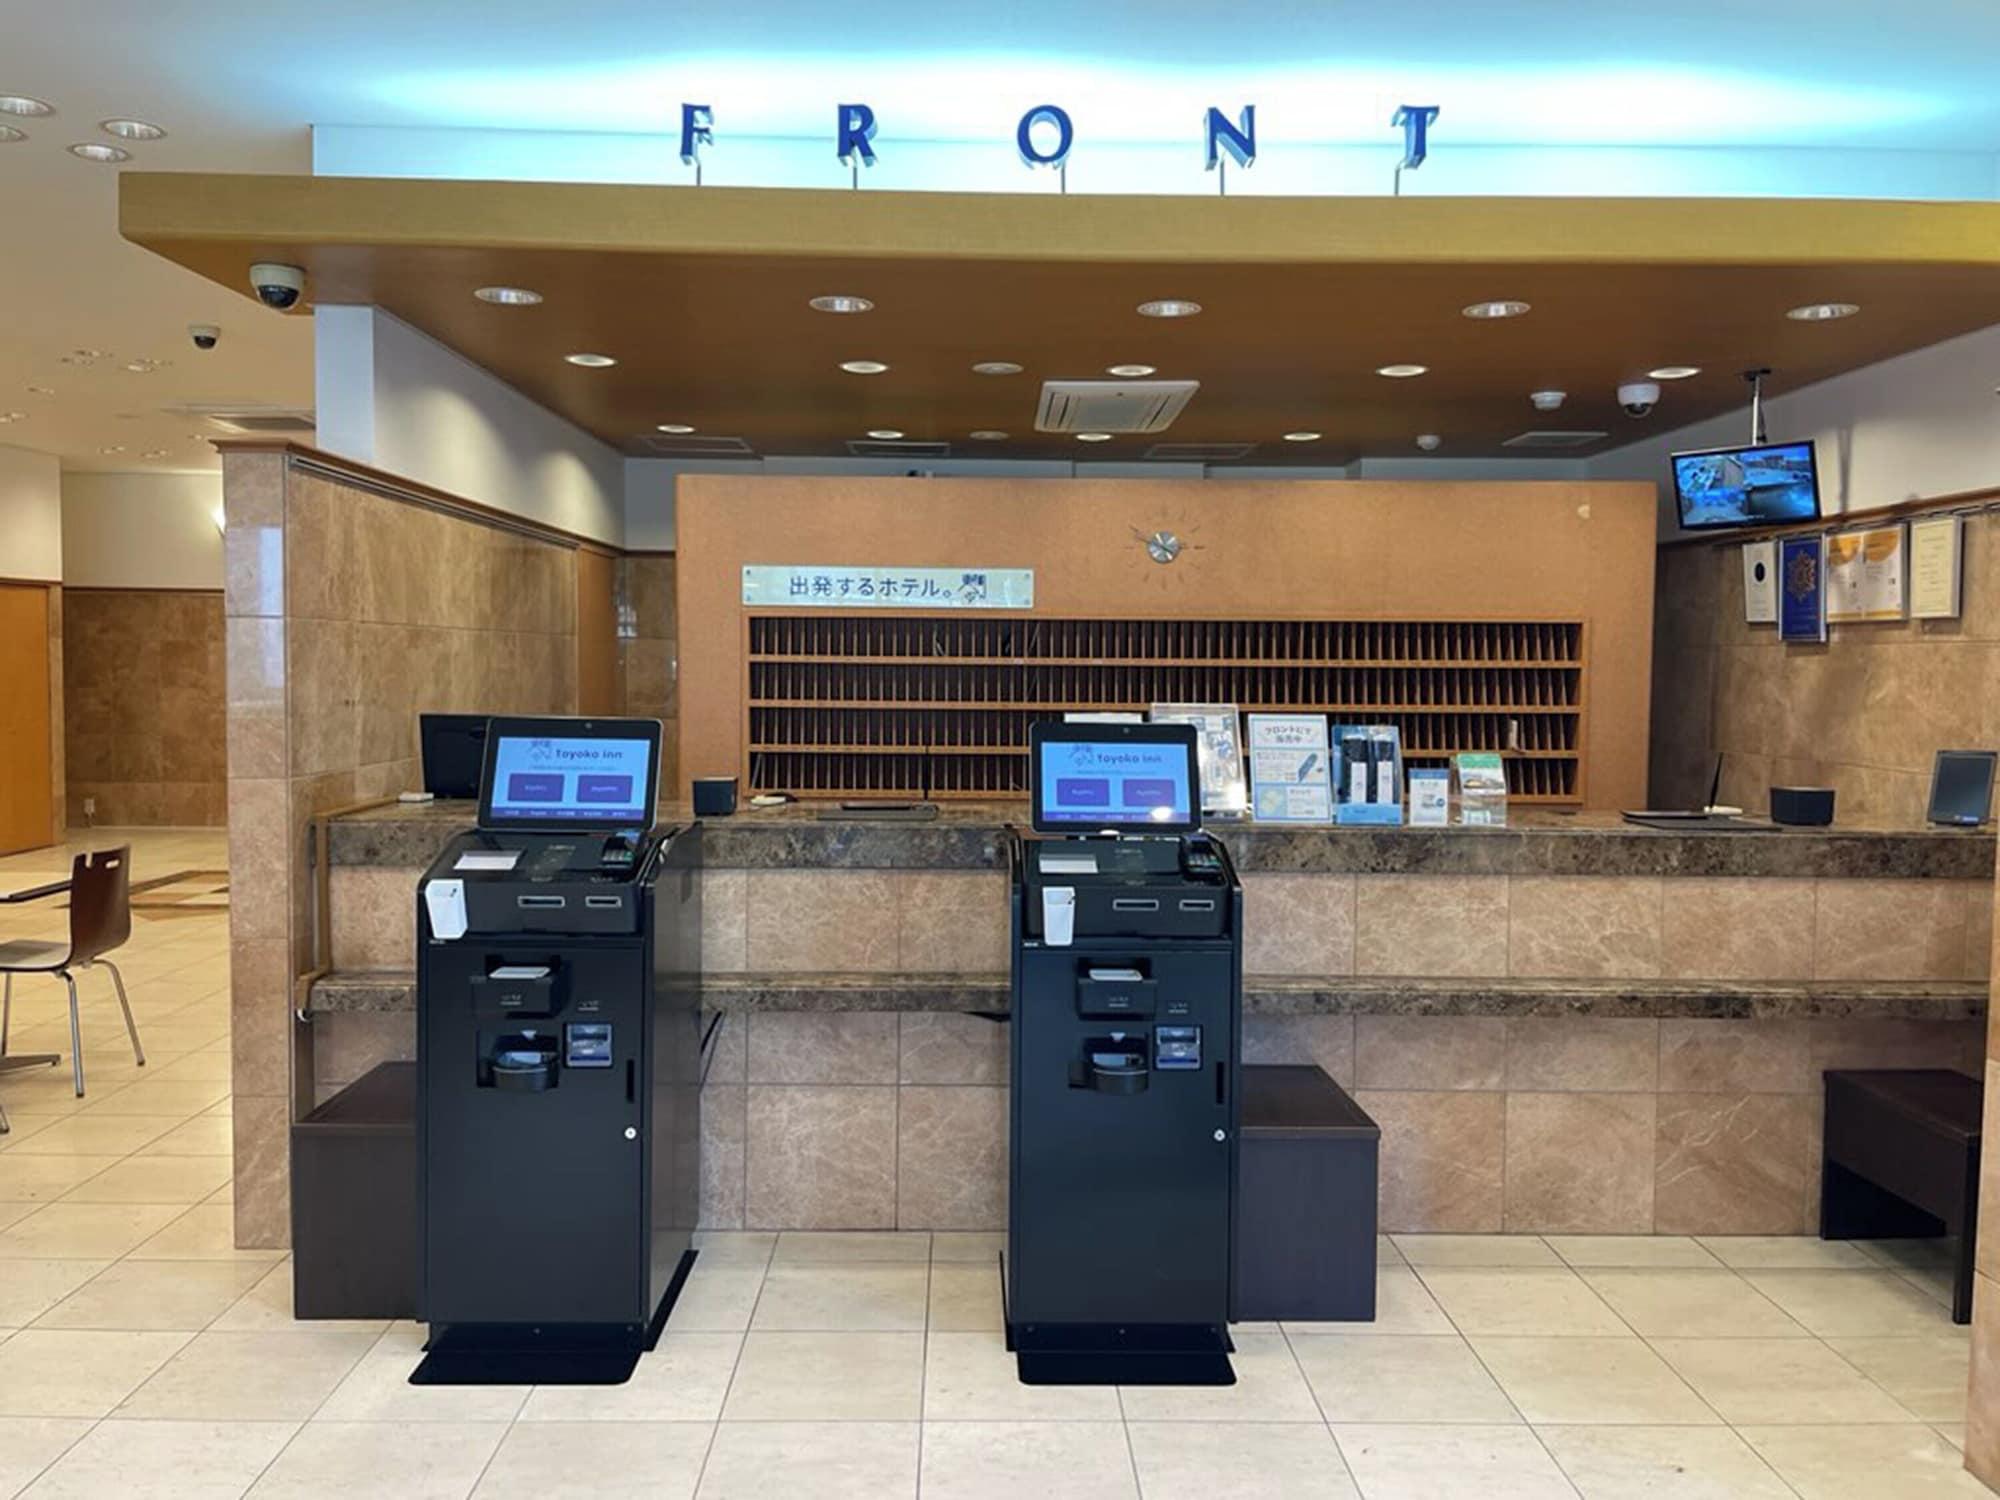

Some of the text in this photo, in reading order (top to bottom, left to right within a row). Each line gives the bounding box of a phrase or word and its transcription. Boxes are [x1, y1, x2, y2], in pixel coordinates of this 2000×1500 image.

[679, 102, 1440, 169] FRONT
[789, 575, 952, 599] 出発するホテル。
